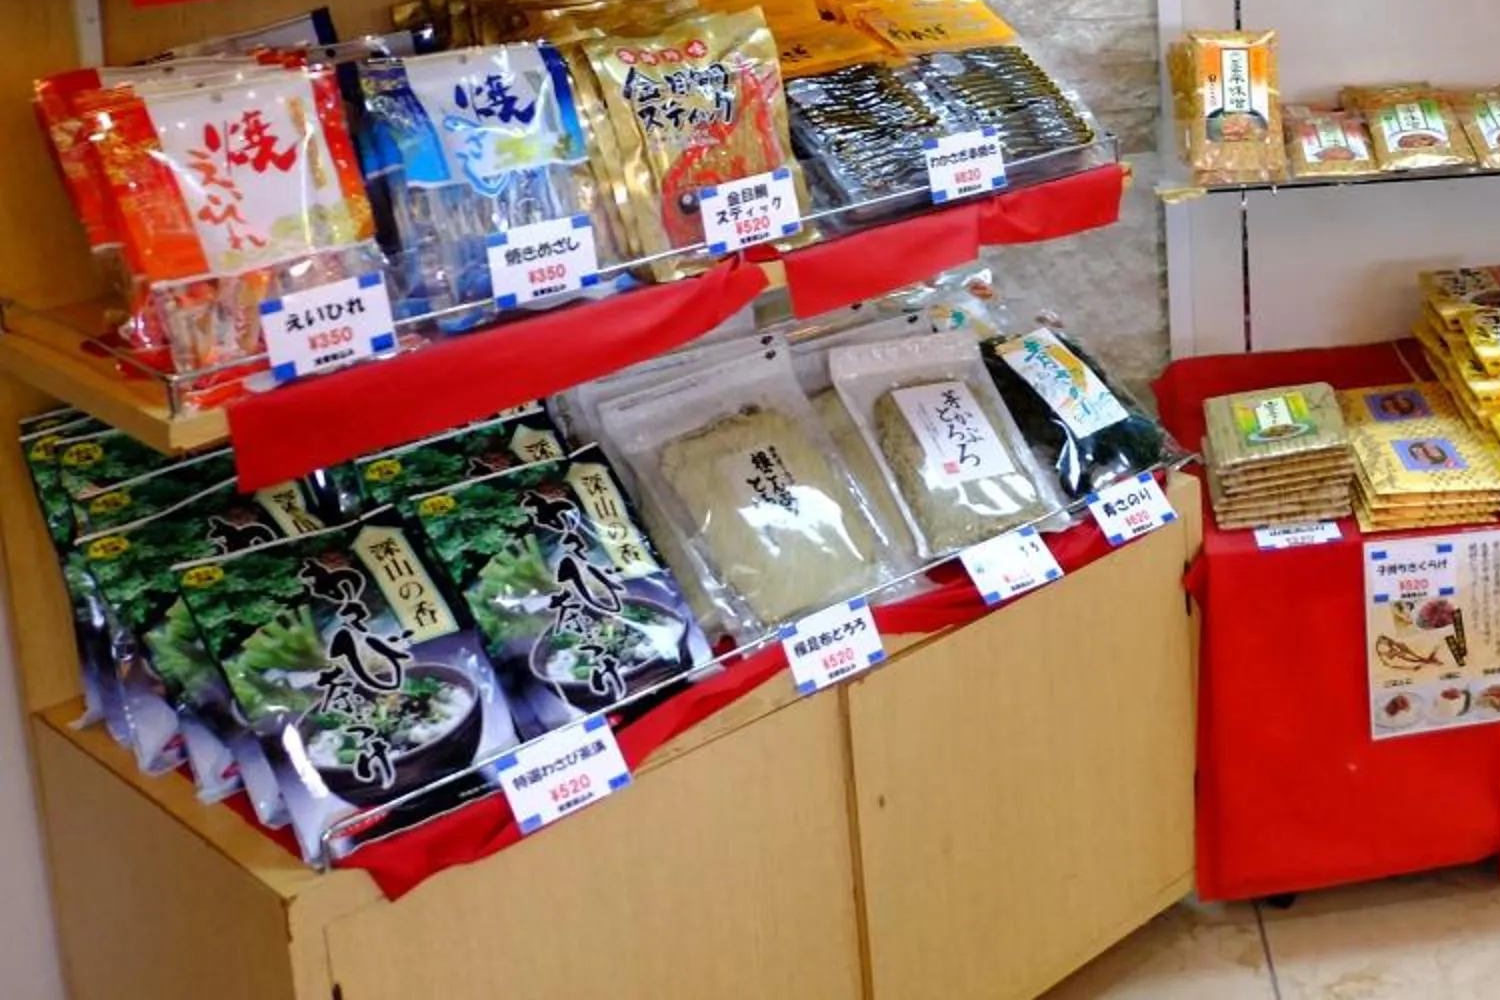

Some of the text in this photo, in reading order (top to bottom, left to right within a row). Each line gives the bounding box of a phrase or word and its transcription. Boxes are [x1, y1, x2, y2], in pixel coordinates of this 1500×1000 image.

[735, 215, 771, 236] ¥520
[504, 236, 580, 267] 焼きめざし
[528, 263, 568, 284] ¥350
[286, 297, 366, 333] えいひれ
[307, 325, 353, 351] ¥350
[1102, 486, 1154, 518] 青さのり
[368, 537, 440, 628] 深山の香
[794, 617, 868, 658] 根昆布とろろ
[549, 773, 592, 803] ¥520
